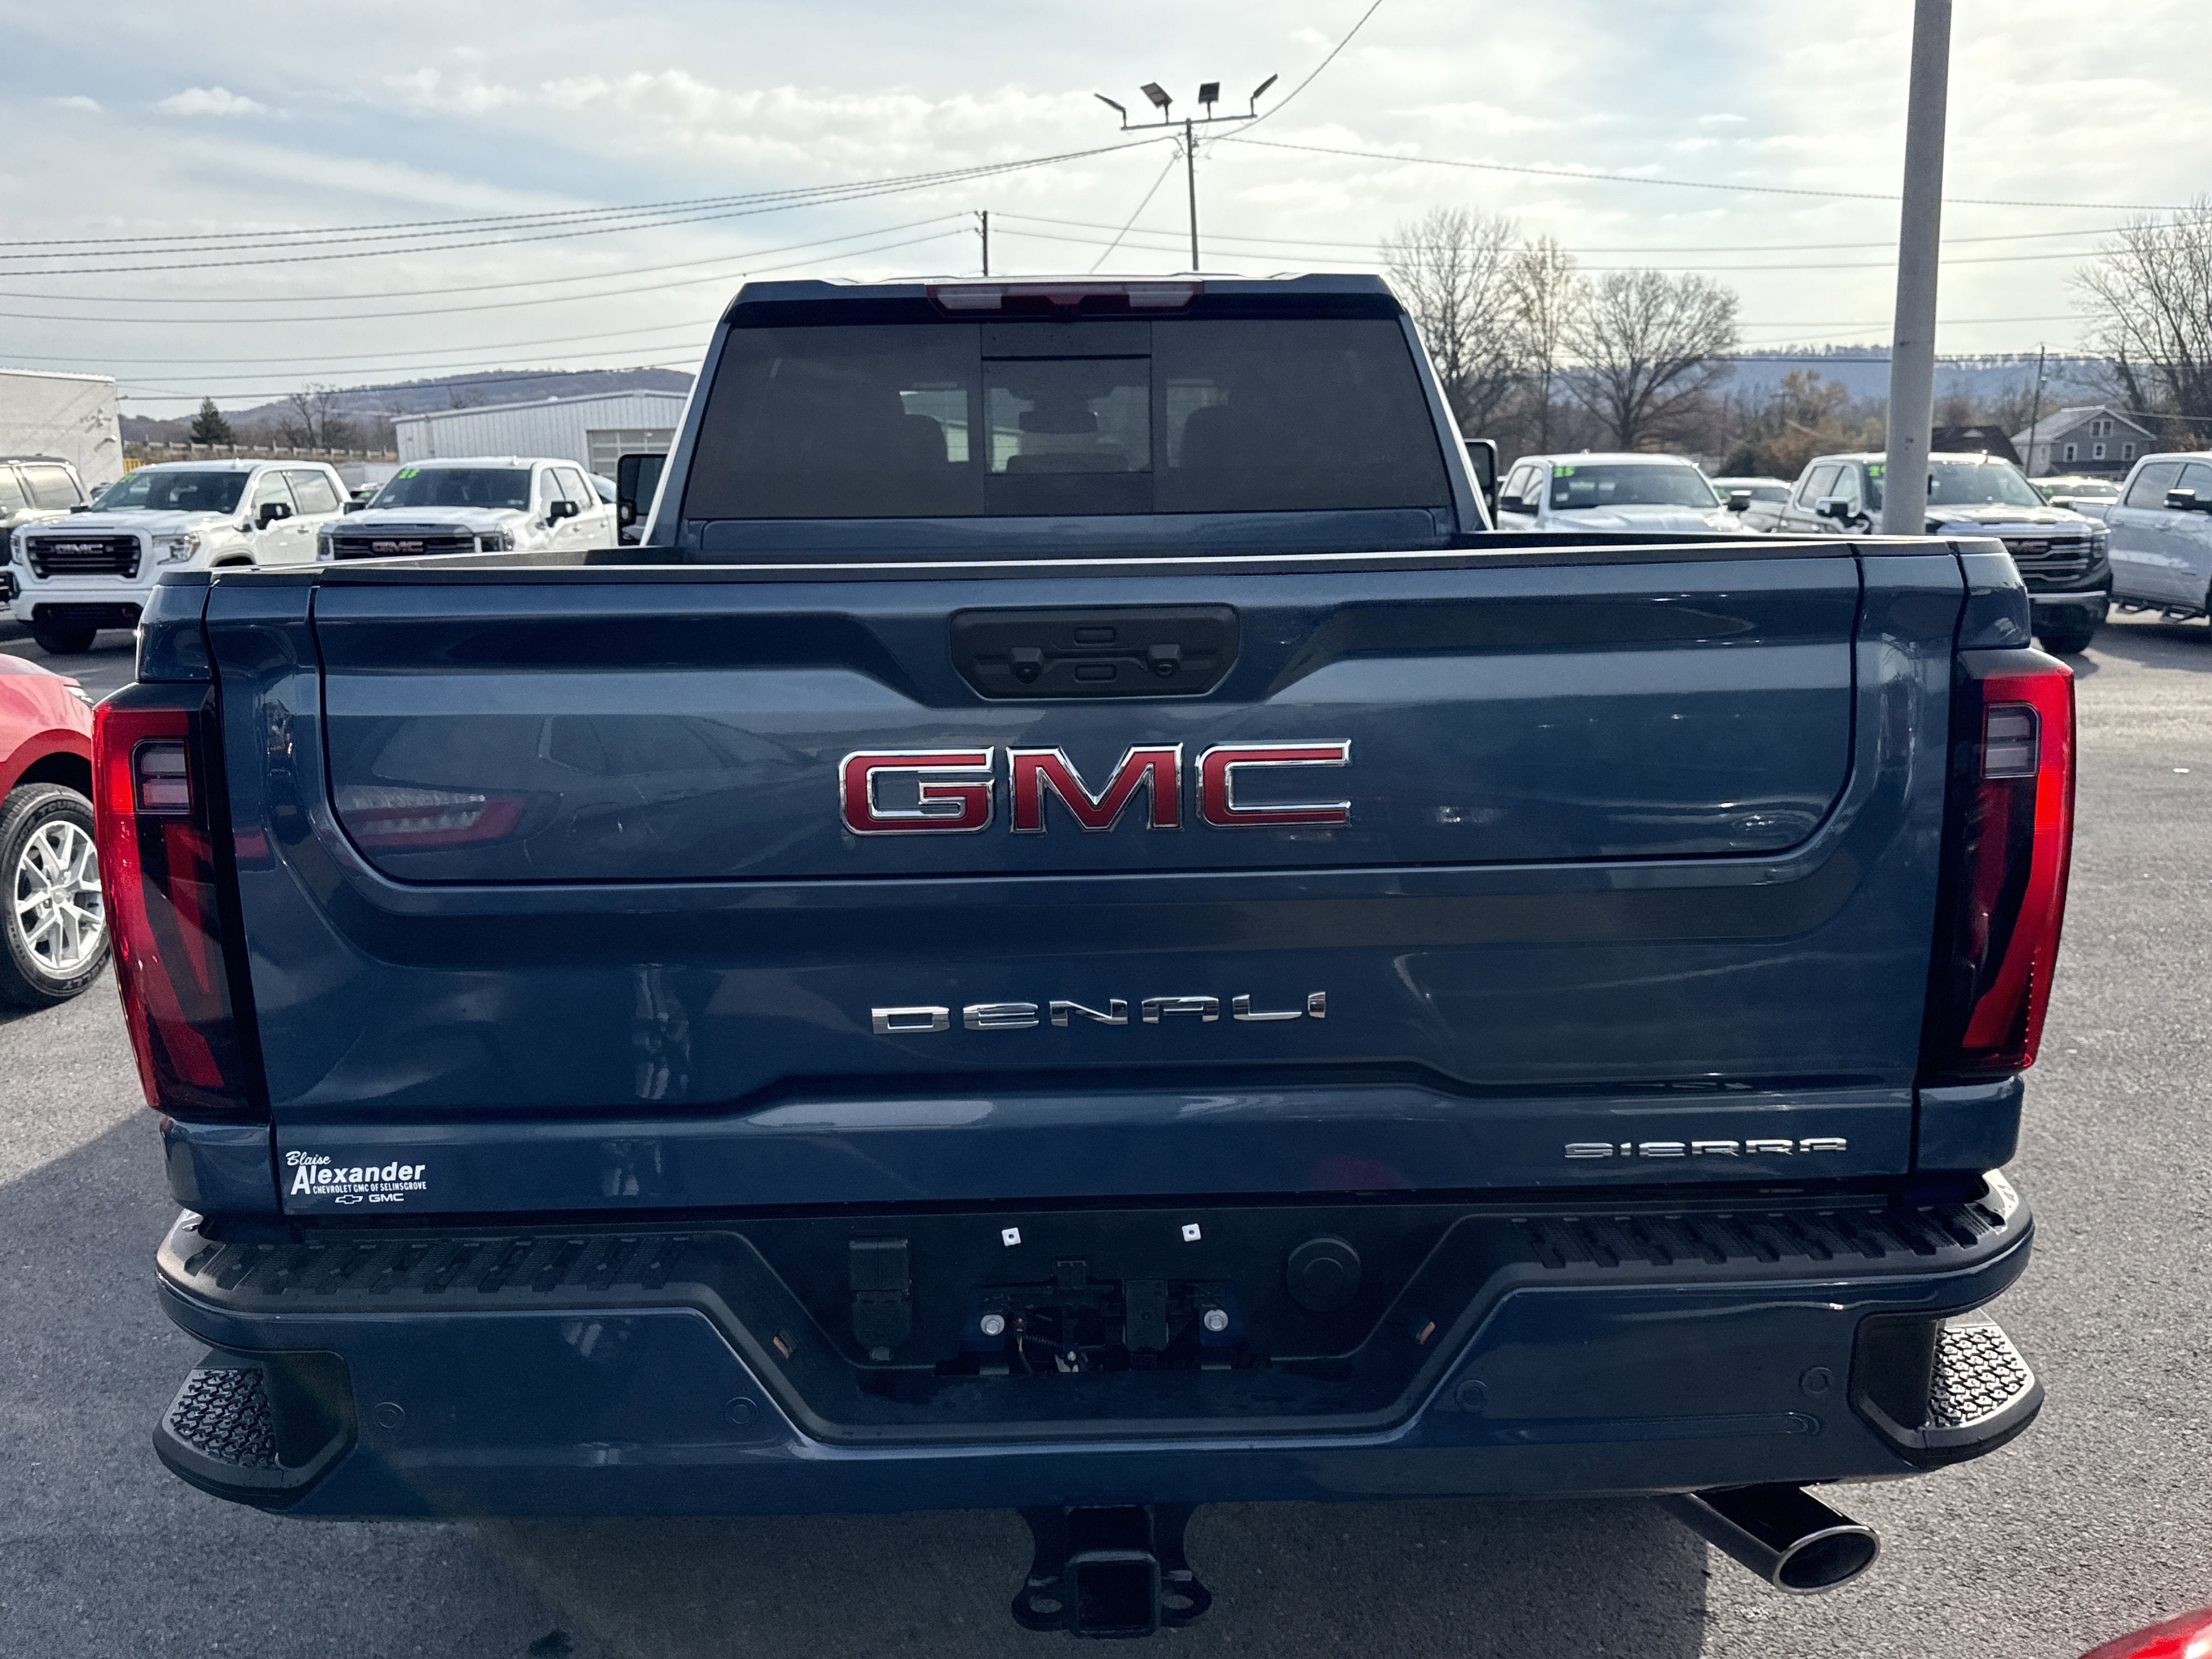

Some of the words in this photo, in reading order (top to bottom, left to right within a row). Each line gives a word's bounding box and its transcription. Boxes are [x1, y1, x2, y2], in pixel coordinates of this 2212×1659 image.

[55, 544, 103, 555] GMC
[373, 541, 424, 552] GMC
[2003, 540, 2049, 553] MC
[839, 738, 1352, 835] GMC
[872, 991, 1326, 1034] DENALI
[1564, 1137, 1847, 1158] SIERRA
[285, 1151, 331, 1166] Blaise
[290, 1161, 426, 1195] Alexander
[313, 1184, 352, 1194] CHEVROLET
[353, 1184, 369, 1193] GMC
[370, 1183, 379, 1192] OF
[380, 1181, 427, 1192] SELINSGROVE
[368, 1193, 404, 1203] GMC
